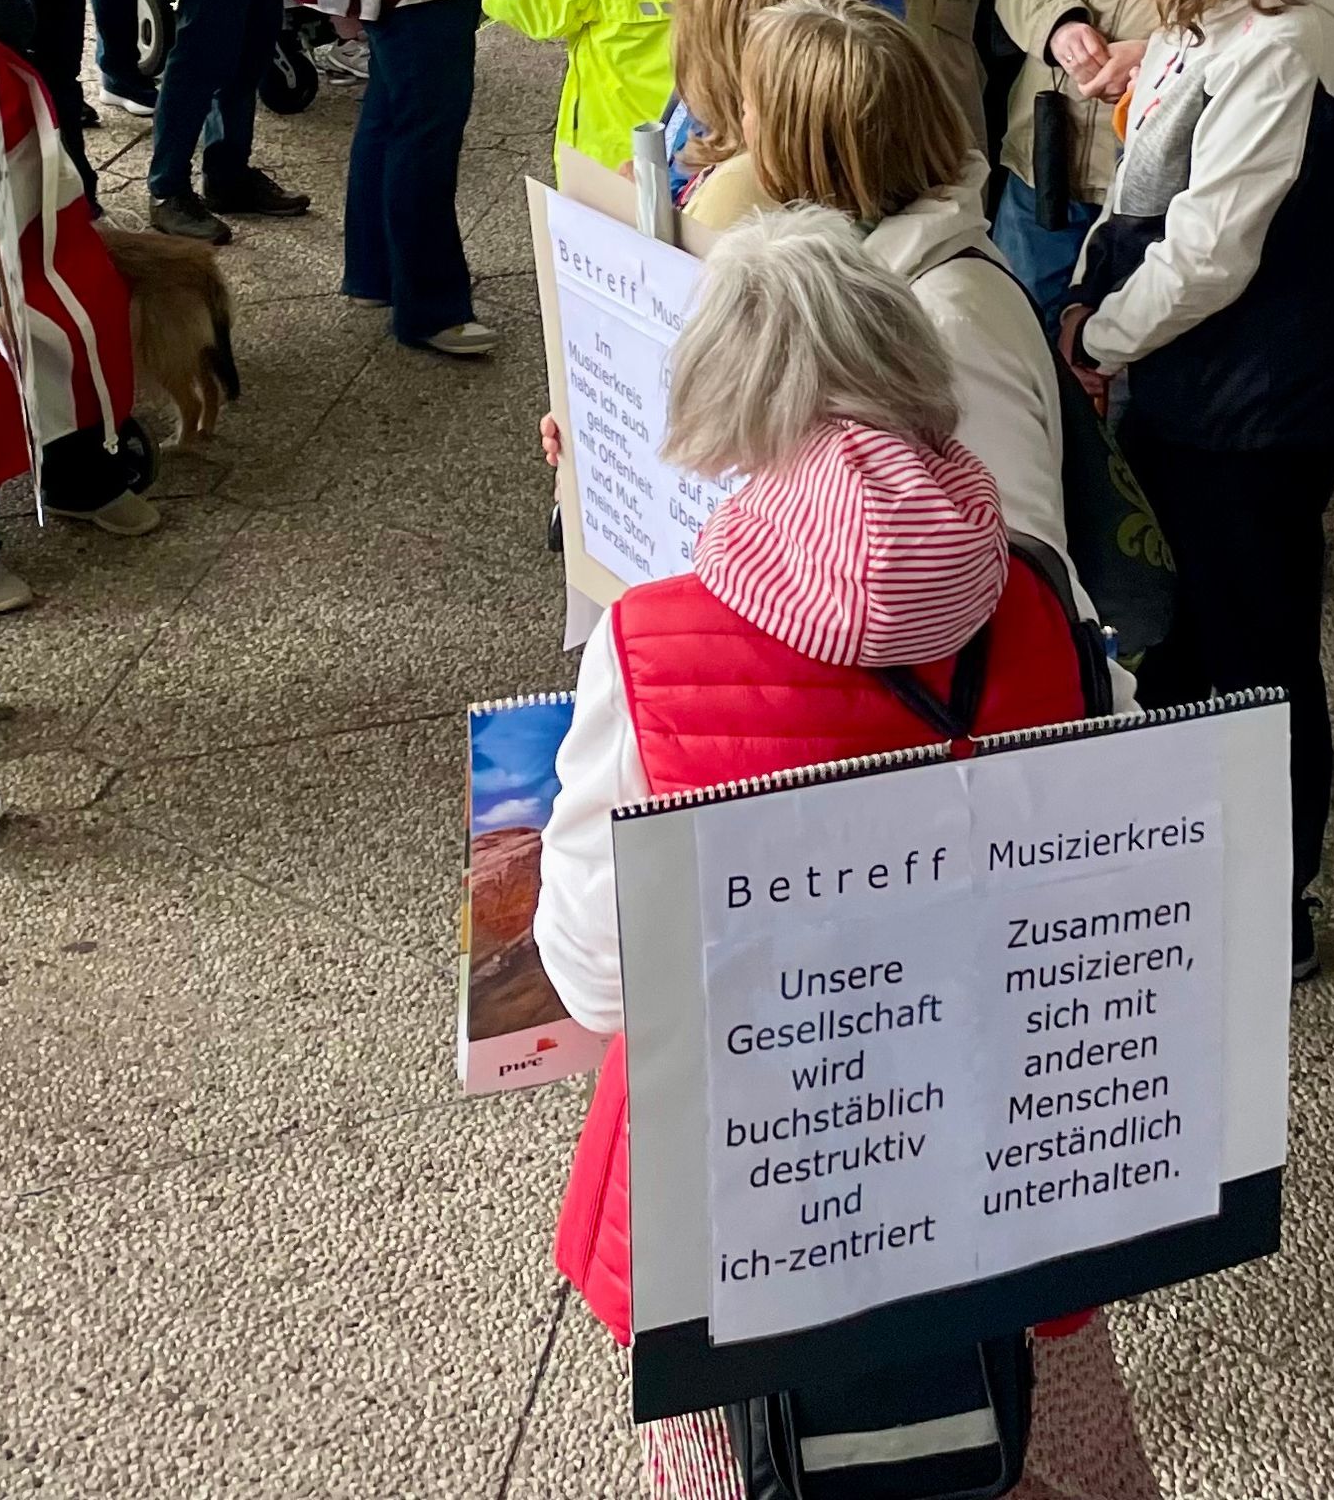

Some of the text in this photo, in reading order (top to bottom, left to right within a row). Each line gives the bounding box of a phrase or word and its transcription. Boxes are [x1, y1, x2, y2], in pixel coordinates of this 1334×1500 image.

[558, 238, 685, 332] Betreff Musi
[595, 332, 612, 359] Im
[568, 339, 643, 411] Musizierkreis
[570, 367, 649, 443] habe ich auch
[579, 429, 654, 501] mit Offenheit
[591, 465, 613, 494] und
[678, 475, 701, 505] auf
[585, 509, 655, 579] zu erzählen.
[586, 486, 656, 557] meine Story
[681, 540, 695, 563] al
[728, 815, 1205, 908] Betreff Musizierkreis
[1007, 900, 1191, 949] Zusammen
[781, 960, 903, 1001] Unsere
[1006, 944, 1194, 993] musizieren,
[727, 994, 943, 1056] Gesellschaft
[1026, 988, 1157, 1034] sich mit
[792, 1049, 865, 1092] wird
[1024, 1035, 1158, 1078] anderen
[727, 1081, 944, 1147] buchstäblich
[1009, 1075, 1169, 1124] Menschen
[750, 1131, 926, 1188] destruktiv
[985, 1109, 1182, 1172] verständlich
[801, 1183, 862, 1225] und
[983, 1158, 1180, 1216] unterhalten.
[721, 1215, 937, 1283] ich-zentriert
